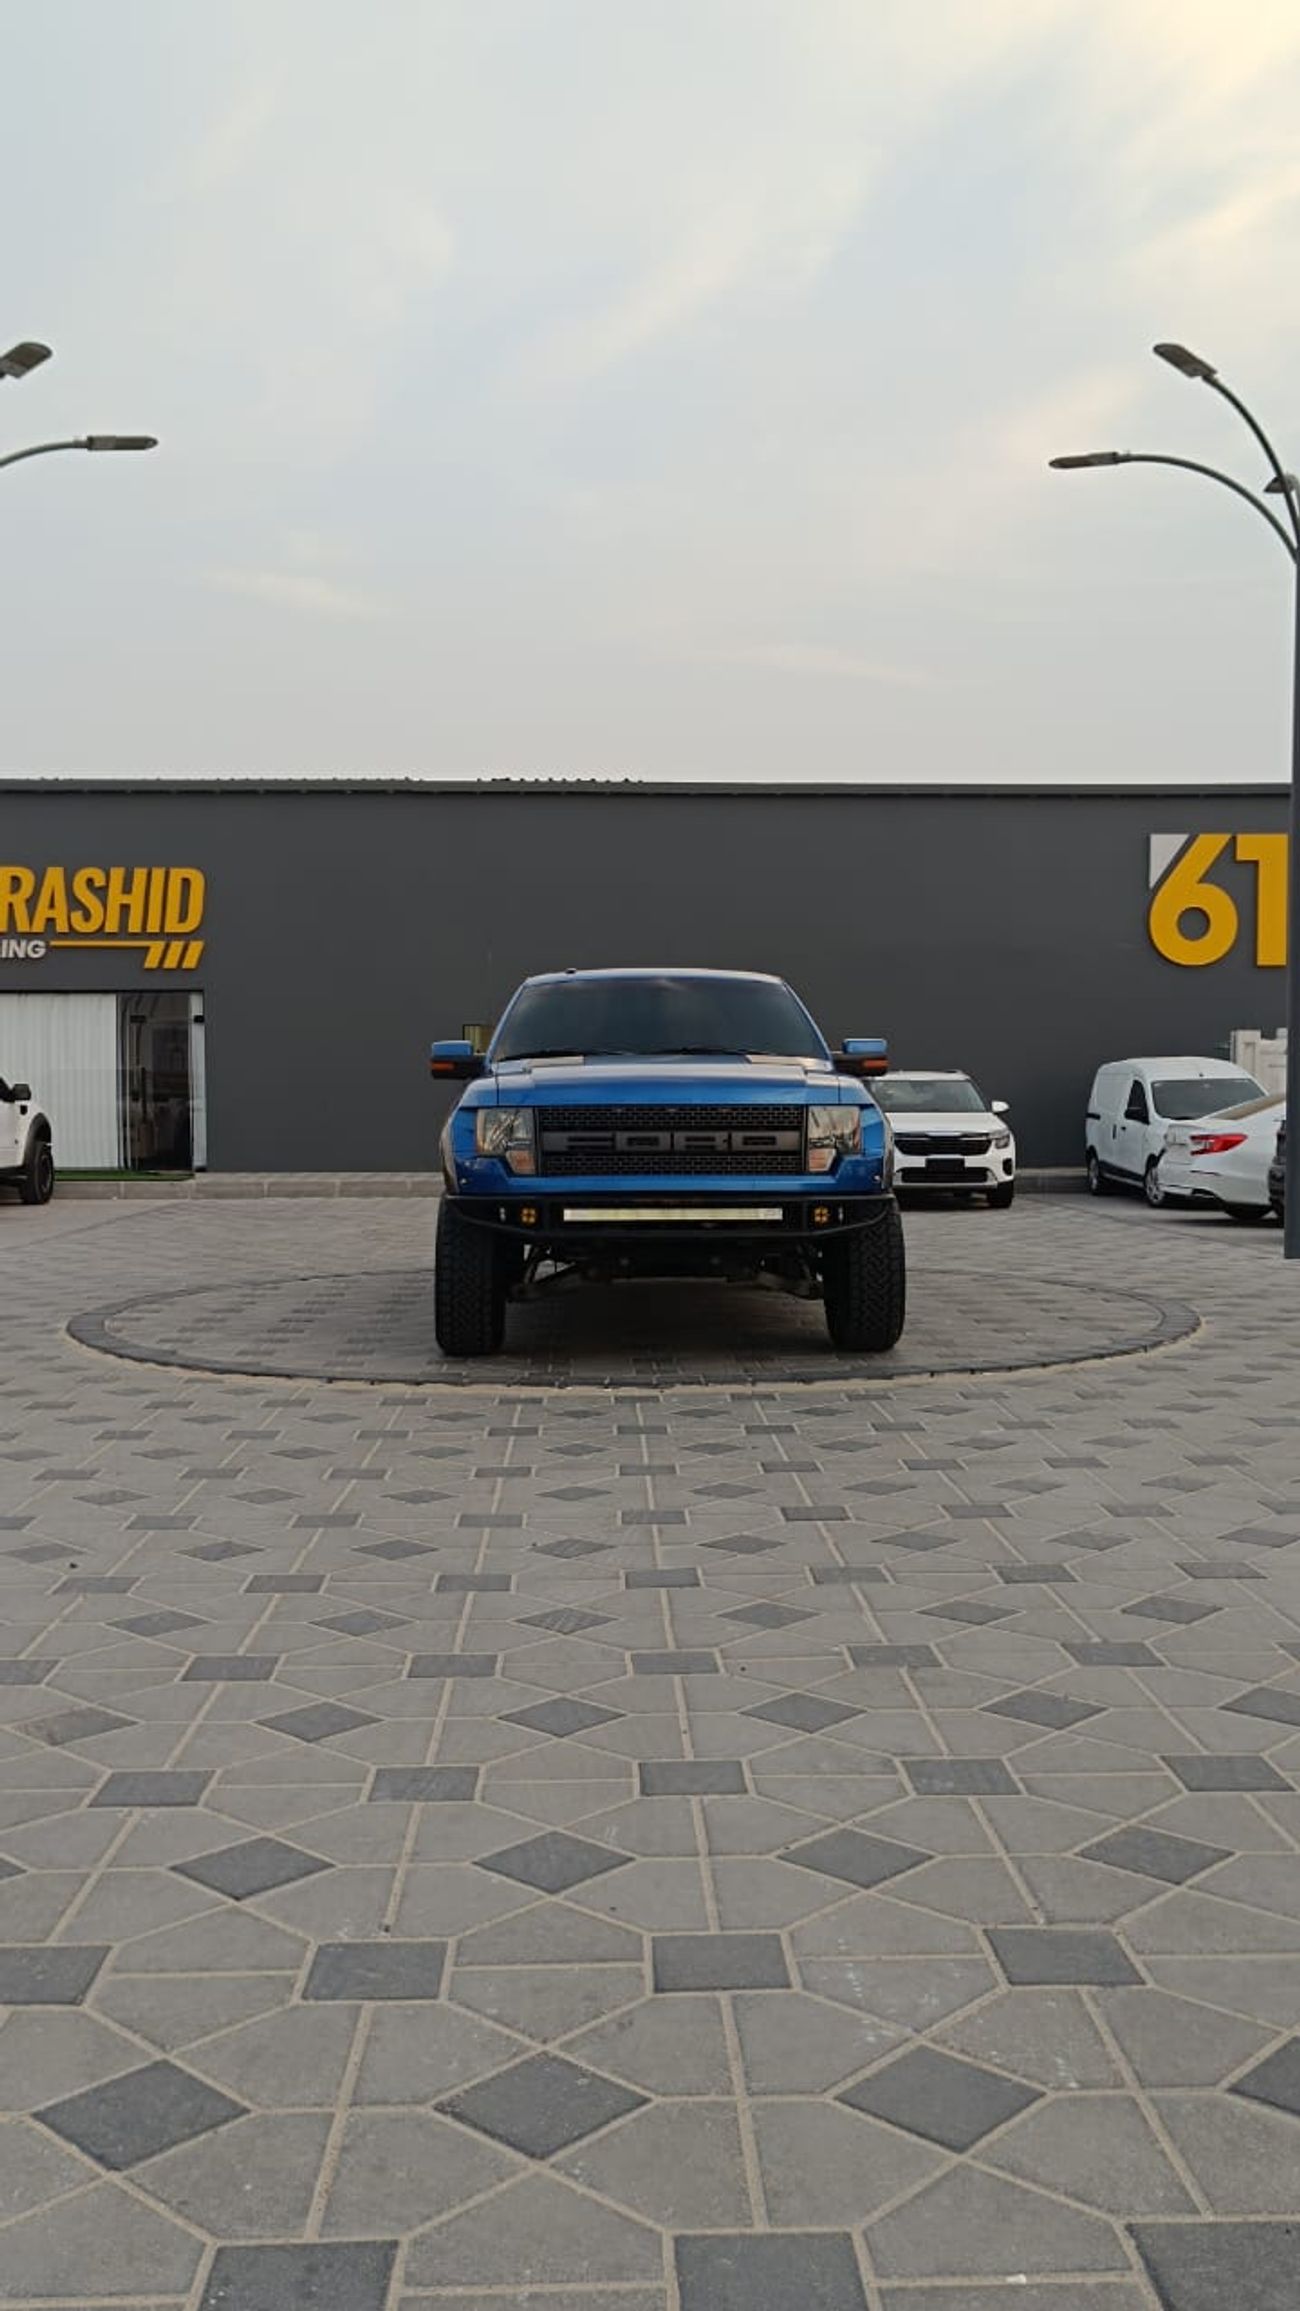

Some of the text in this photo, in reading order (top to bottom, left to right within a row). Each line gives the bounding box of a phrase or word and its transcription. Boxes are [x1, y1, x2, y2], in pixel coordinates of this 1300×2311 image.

[0, 866, 205, 933] RASHID
[1149, 834, 1289, 966] 61
[0, 939, 46, 958] ING
